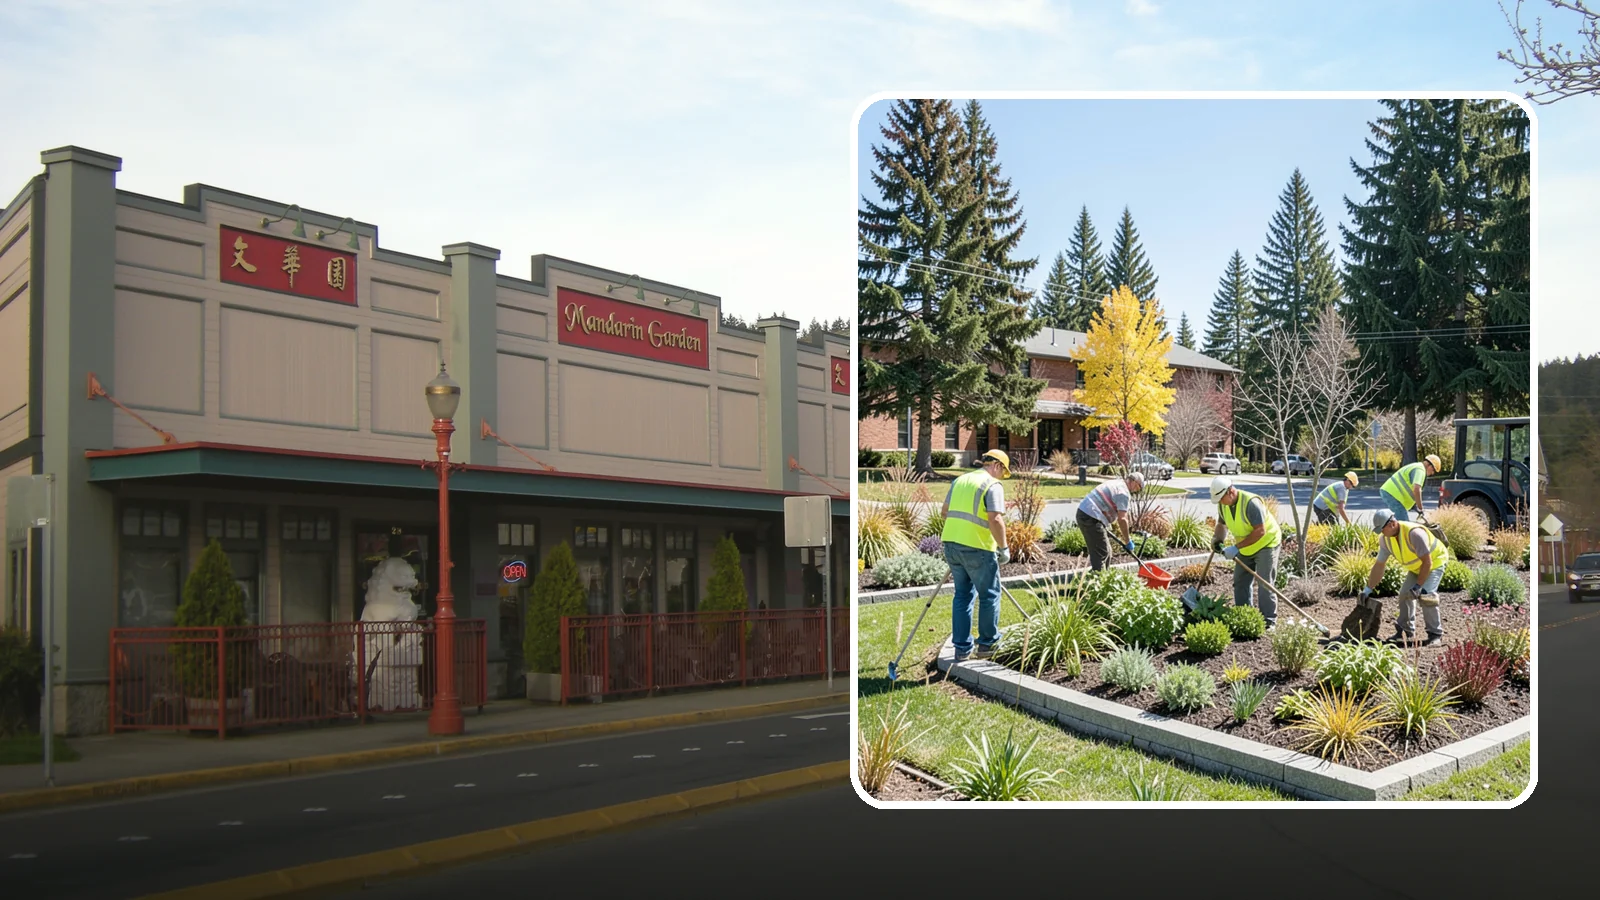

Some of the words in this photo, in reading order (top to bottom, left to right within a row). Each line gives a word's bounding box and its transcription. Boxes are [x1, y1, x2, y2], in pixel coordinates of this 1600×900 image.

[231, 236, 346, 291] 文華園
[564, 302, 644, 341] Mandarin
[647, 320, 702, 352] Garden
[503, 565, 527, 578] OPEN
